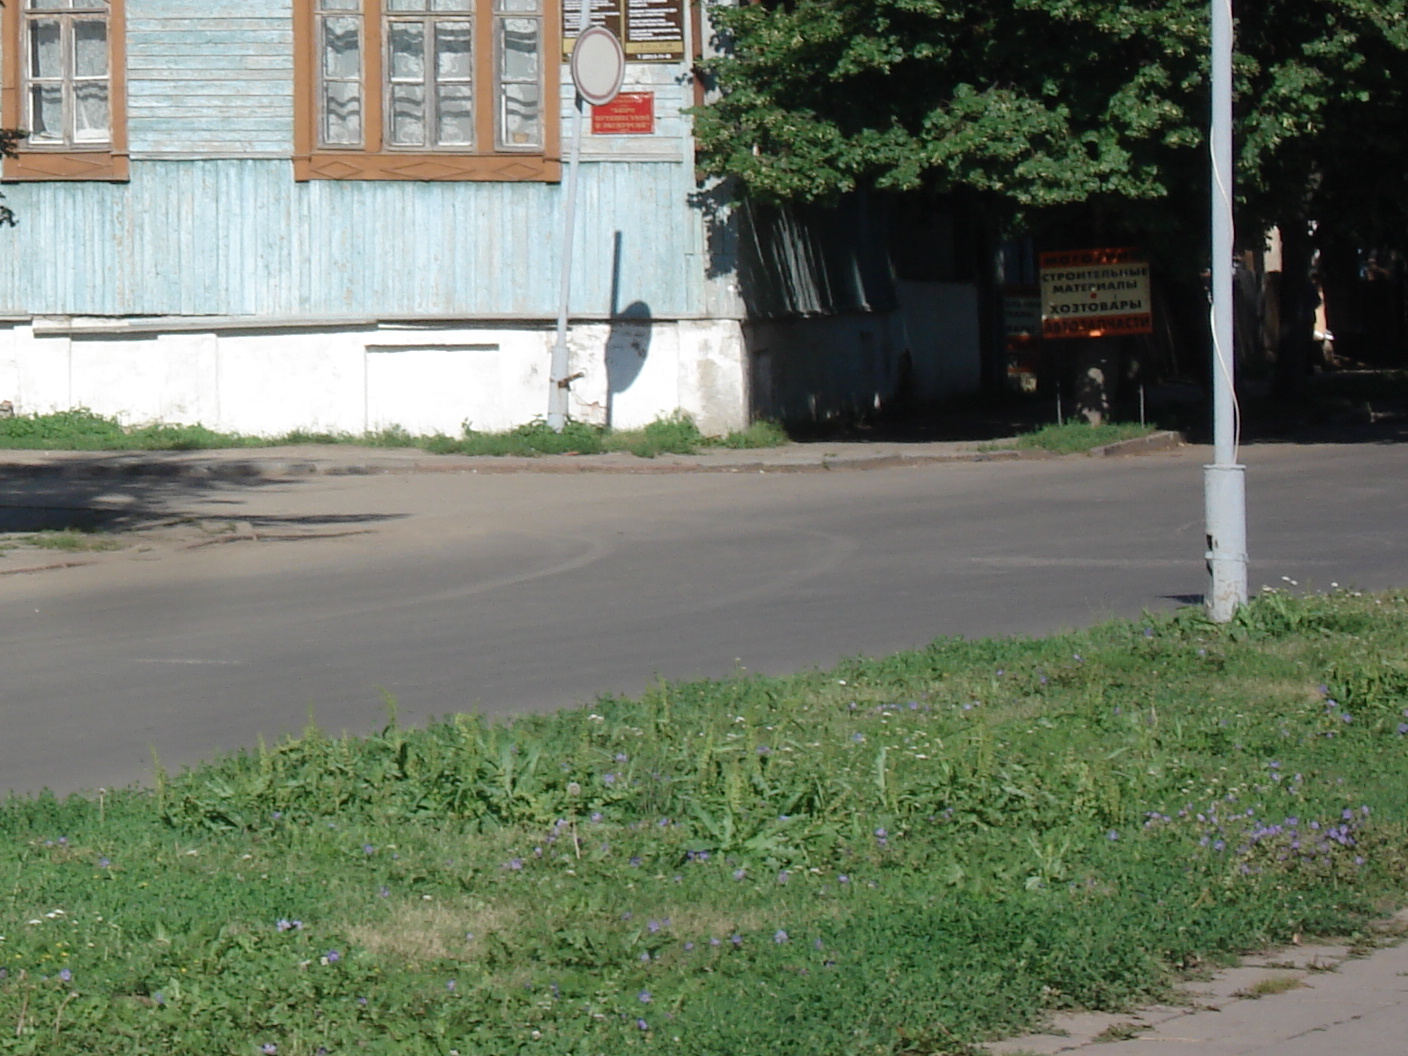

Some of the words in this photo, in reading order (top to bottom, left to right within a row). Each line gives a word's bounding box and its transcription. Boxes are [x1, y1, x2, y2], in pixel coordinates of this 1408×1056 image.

[1042, 267, 1147, 282] СТРОИТЕЛЬНЫЕ
[1053, 280, 1138, 294] МАТЕРИАЛЫ
[1050, 300, 1142, 315] ХОЗТОВАРЫ
